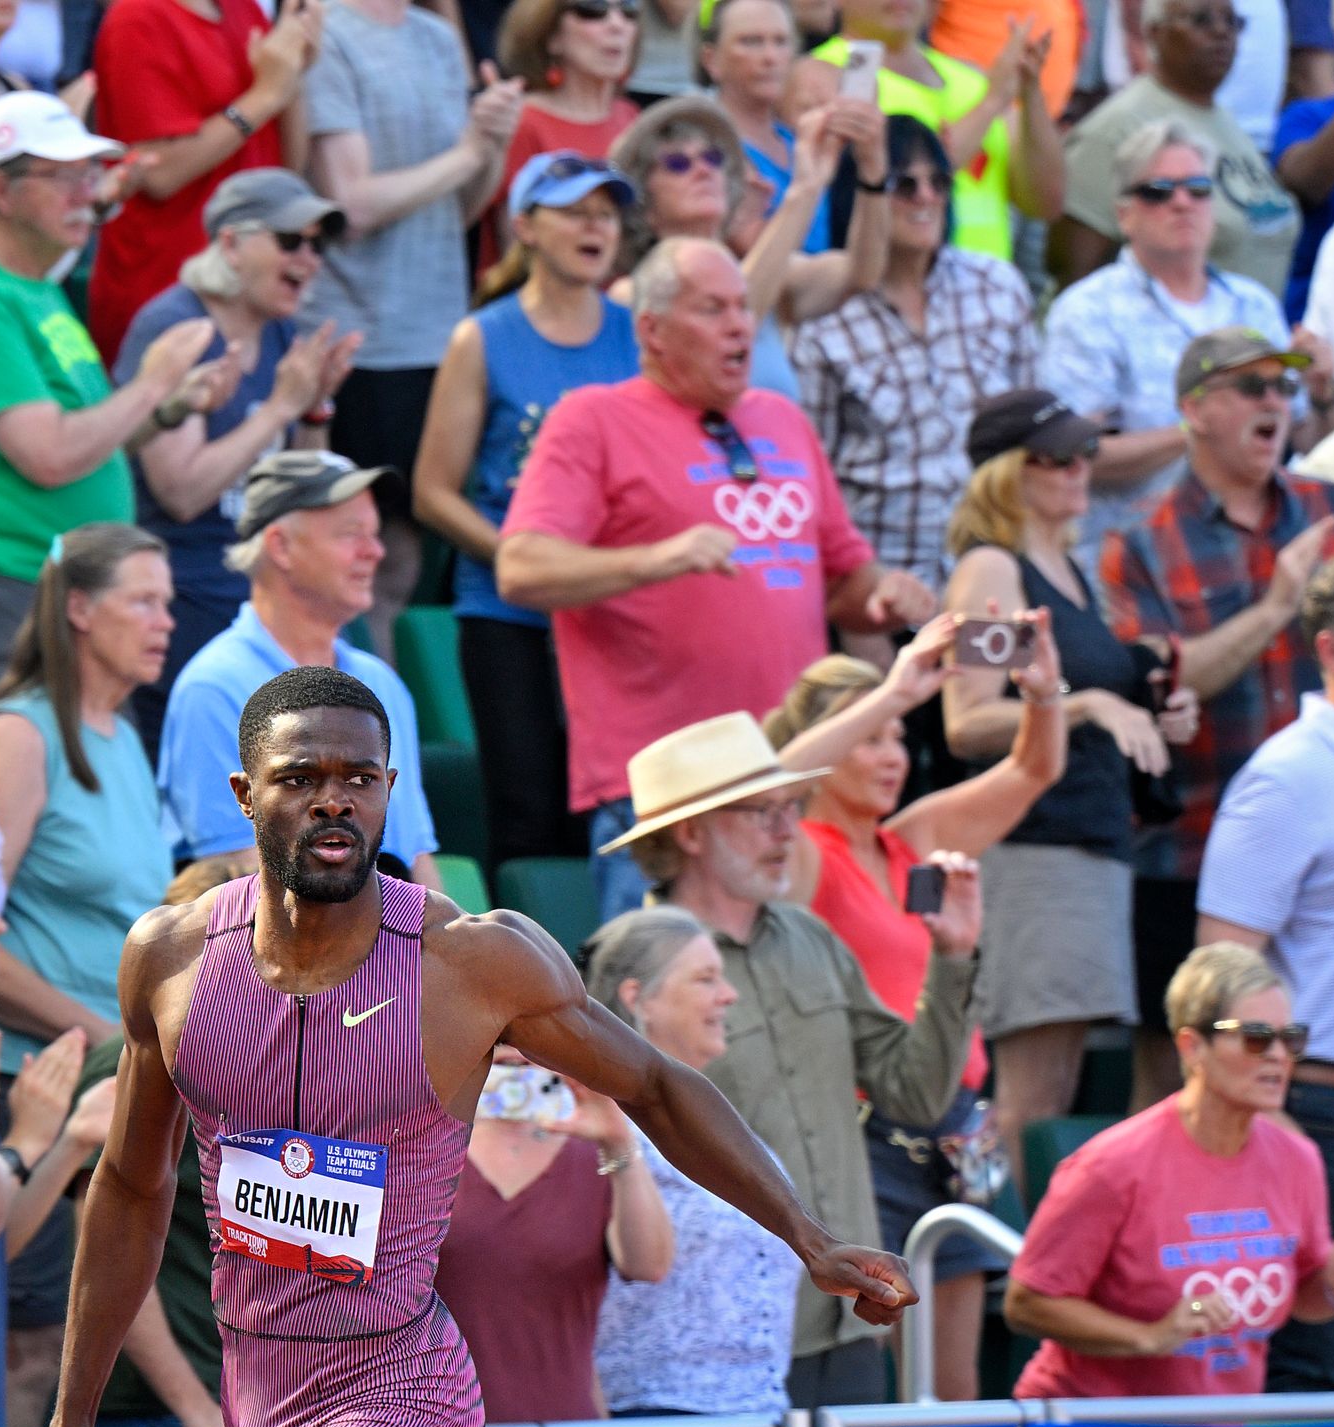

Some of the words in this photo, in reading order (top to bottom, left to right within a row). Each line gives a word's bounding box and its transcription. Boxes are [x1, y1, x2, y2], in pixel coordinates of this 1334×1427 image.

[242, 1136, 275, 1146] USATF
[327, 1145, 342, 1156] U.S.
[344, 1147, 377, 1160] OLYMPIC
[327, 1155, 347, 1167] TEAM
[349, 1158, 376, 1171] TRIALS
[327, 1166, 343, 1174] TRACK
[348, 1169, 363, 1177] FIELD
[234, 1178, 360, 1238] BENJAMIN
[226, 1227, 268, 1250] TRACKTOWN
